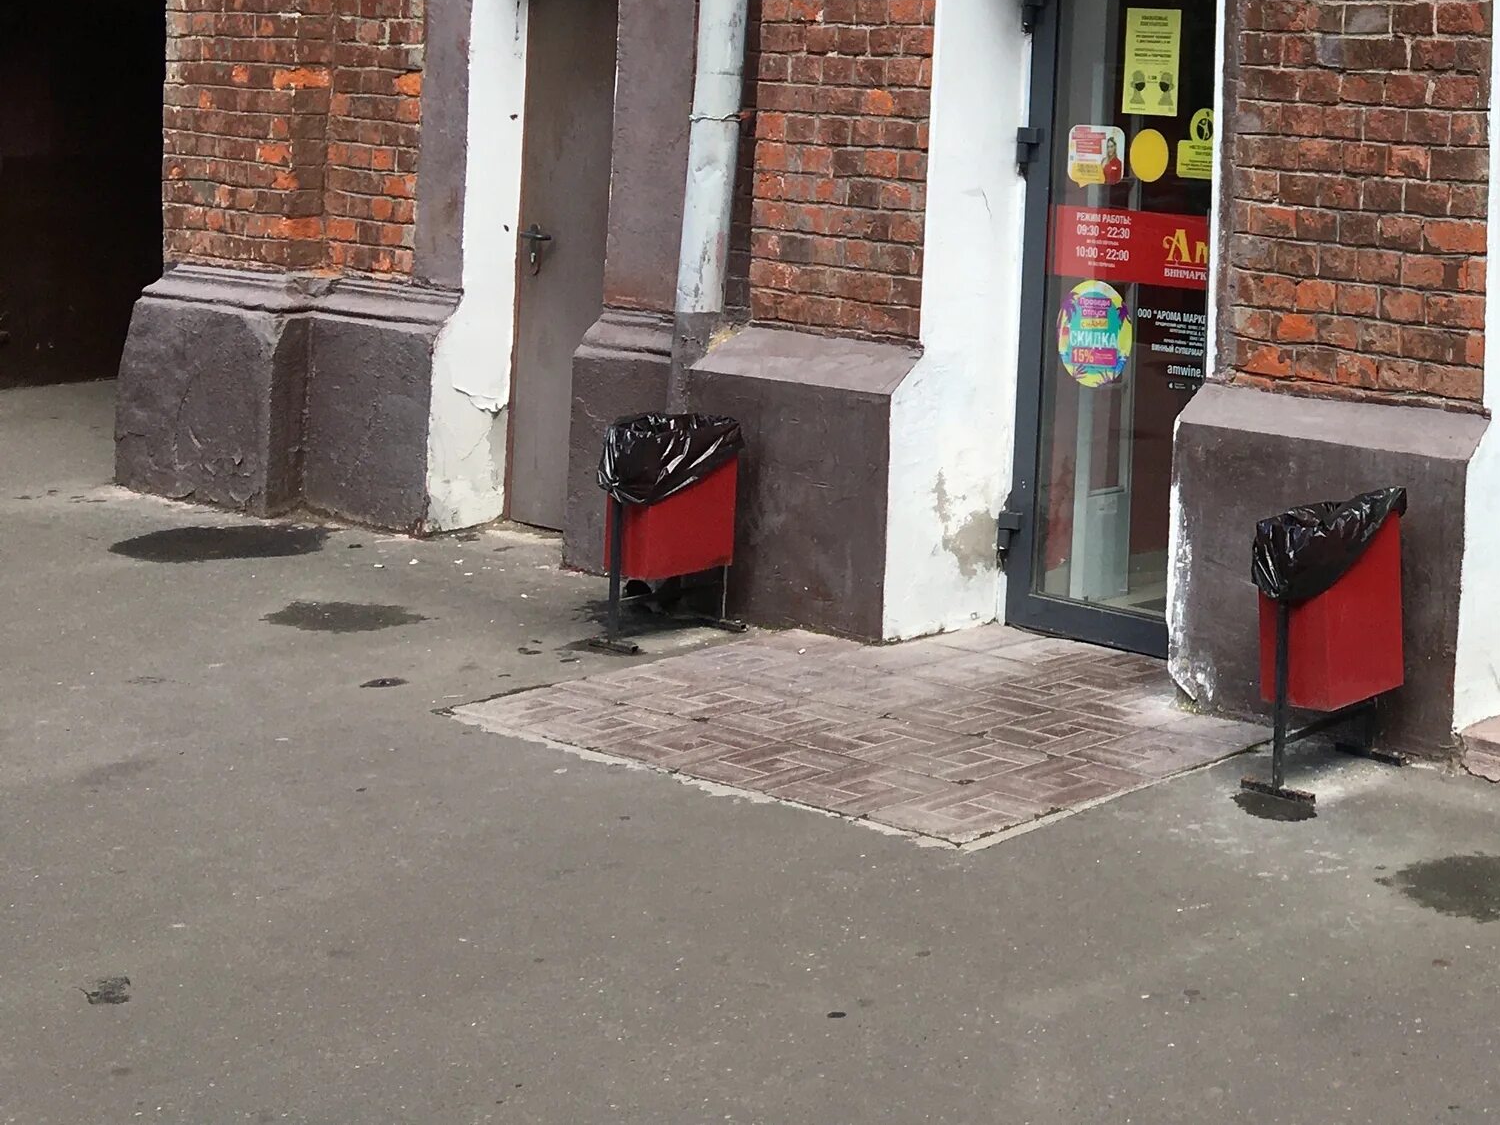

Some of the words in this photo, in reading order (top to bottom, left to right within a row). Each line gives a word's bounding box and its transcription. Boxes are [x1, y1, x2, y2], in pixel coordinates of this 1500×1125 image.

[1076, 224, 1099, 236] 09:30
[1107, 227, 1130, 239] 22:30
[1076, 246, 1098, 258] 10:00
[1106, 248, 1129, 261] 22:00
[1138, 308, 1151, 318] ООО
[1070, 331, 1117, 350] СКИДКА
[1073, 349, 1095, 363] 15%
